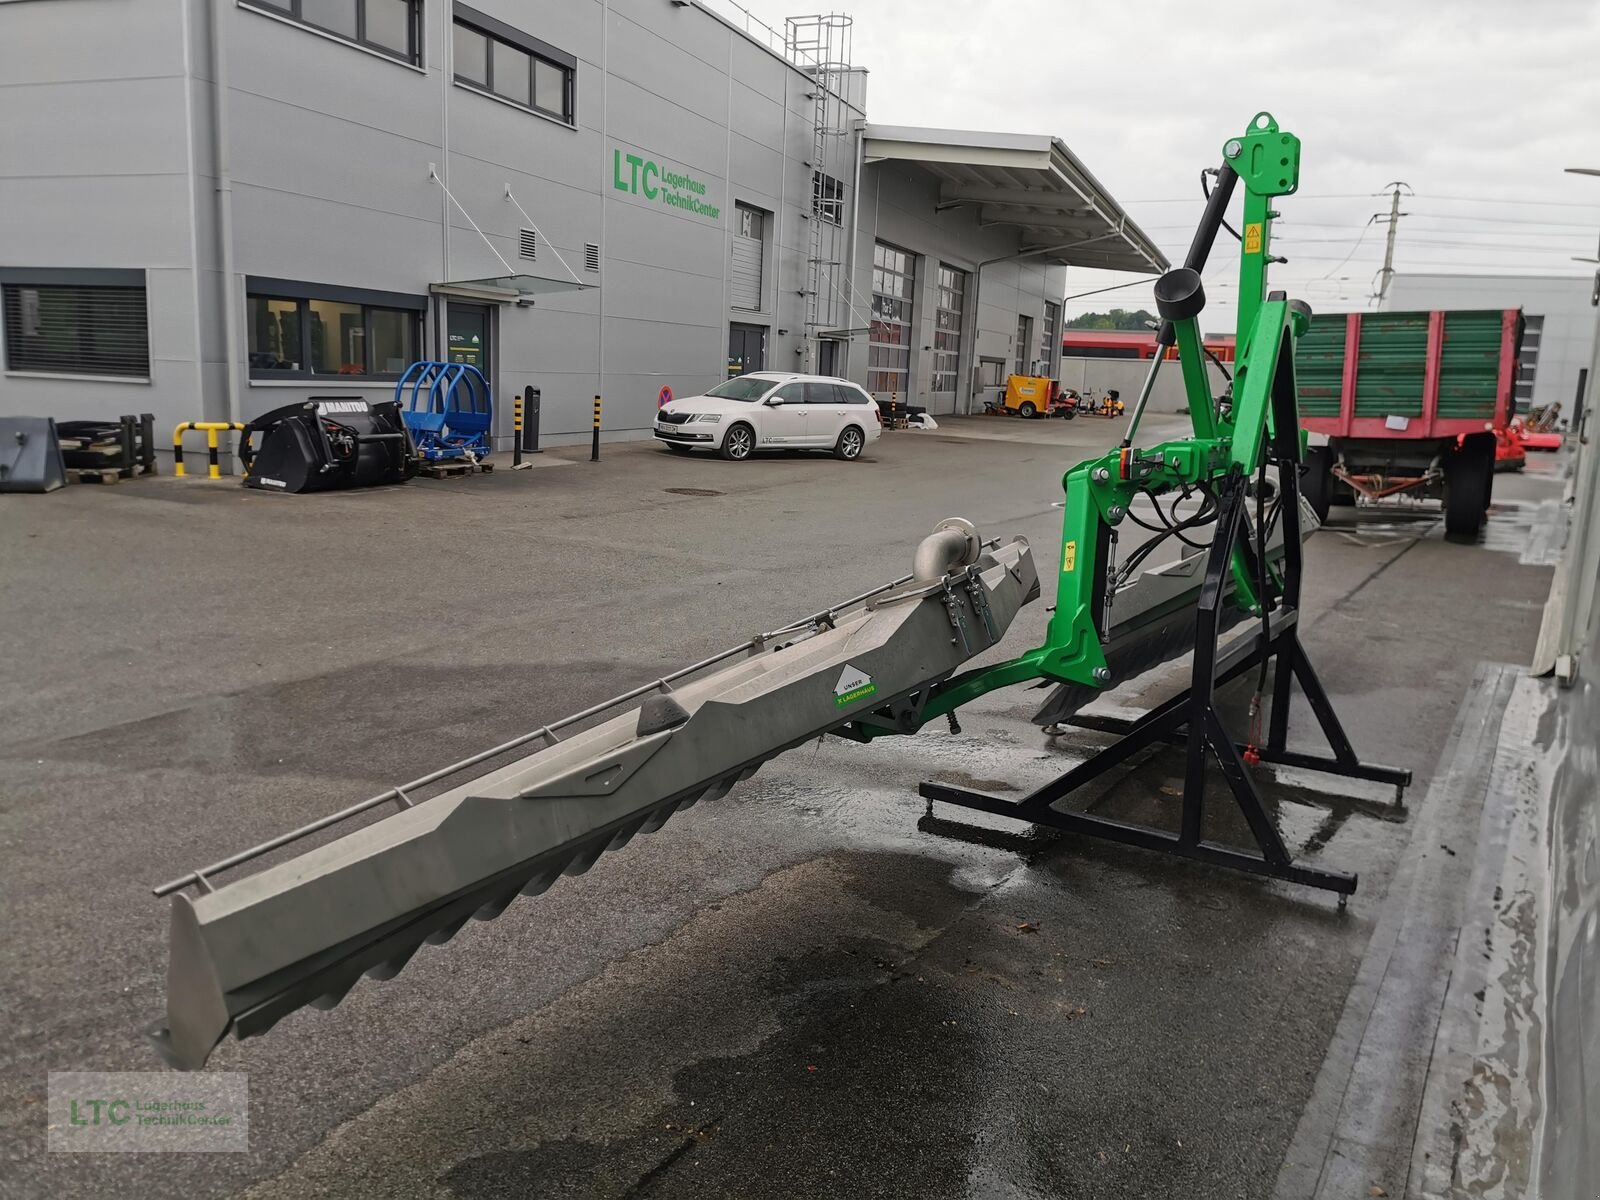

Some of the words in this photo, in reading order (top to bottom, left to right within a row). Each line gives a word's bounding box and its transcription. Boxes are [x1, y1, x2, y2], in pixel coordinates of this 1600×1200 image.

[614, 148, 659, 200] LTC
[661, 166, 706, 196] Lagerhaus
[660, 187, 720, 219] TechnikCenter
[325, 401, 369, 413] MANITOU
[842, 685, 875, 702] LAGERHAUS
[843, 680, 863, 690] UNSER
